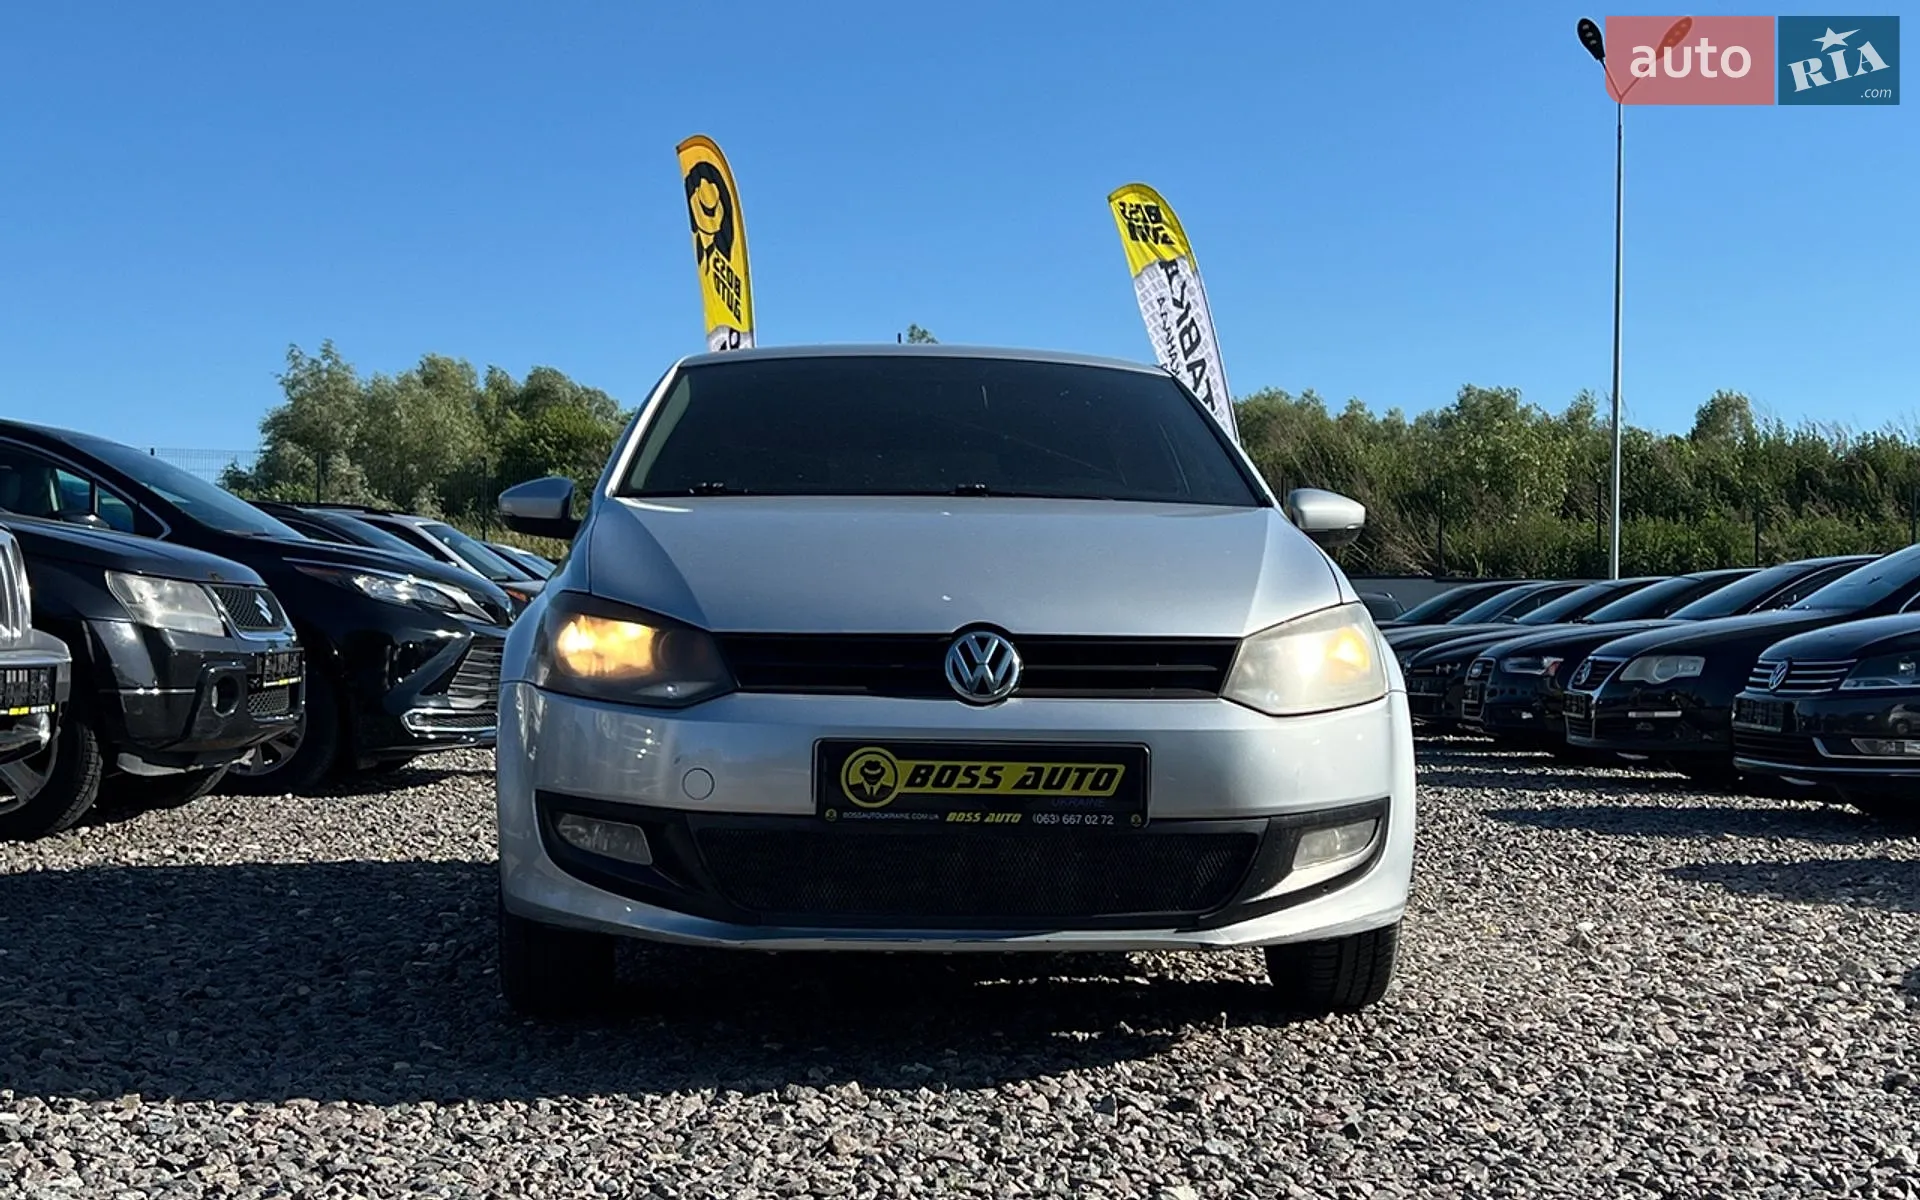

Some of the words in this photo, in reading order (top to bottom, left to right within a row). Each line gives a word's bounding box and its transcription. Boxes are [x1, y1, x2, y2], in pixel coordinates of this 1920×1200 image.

[904, 764, 1004, 789] BOSS
[1012, 766, 1118, 791] AUTO
[945, 812, 981, 823] BOSS
[984, 813, 1023, 824] AUTO
[1032, 813, 1060, 825] (063)
[1062, 814, 1082, 825] 667
[1084, 815, 1099, 825] 02
[1101, 815, 1115, 825] 72
